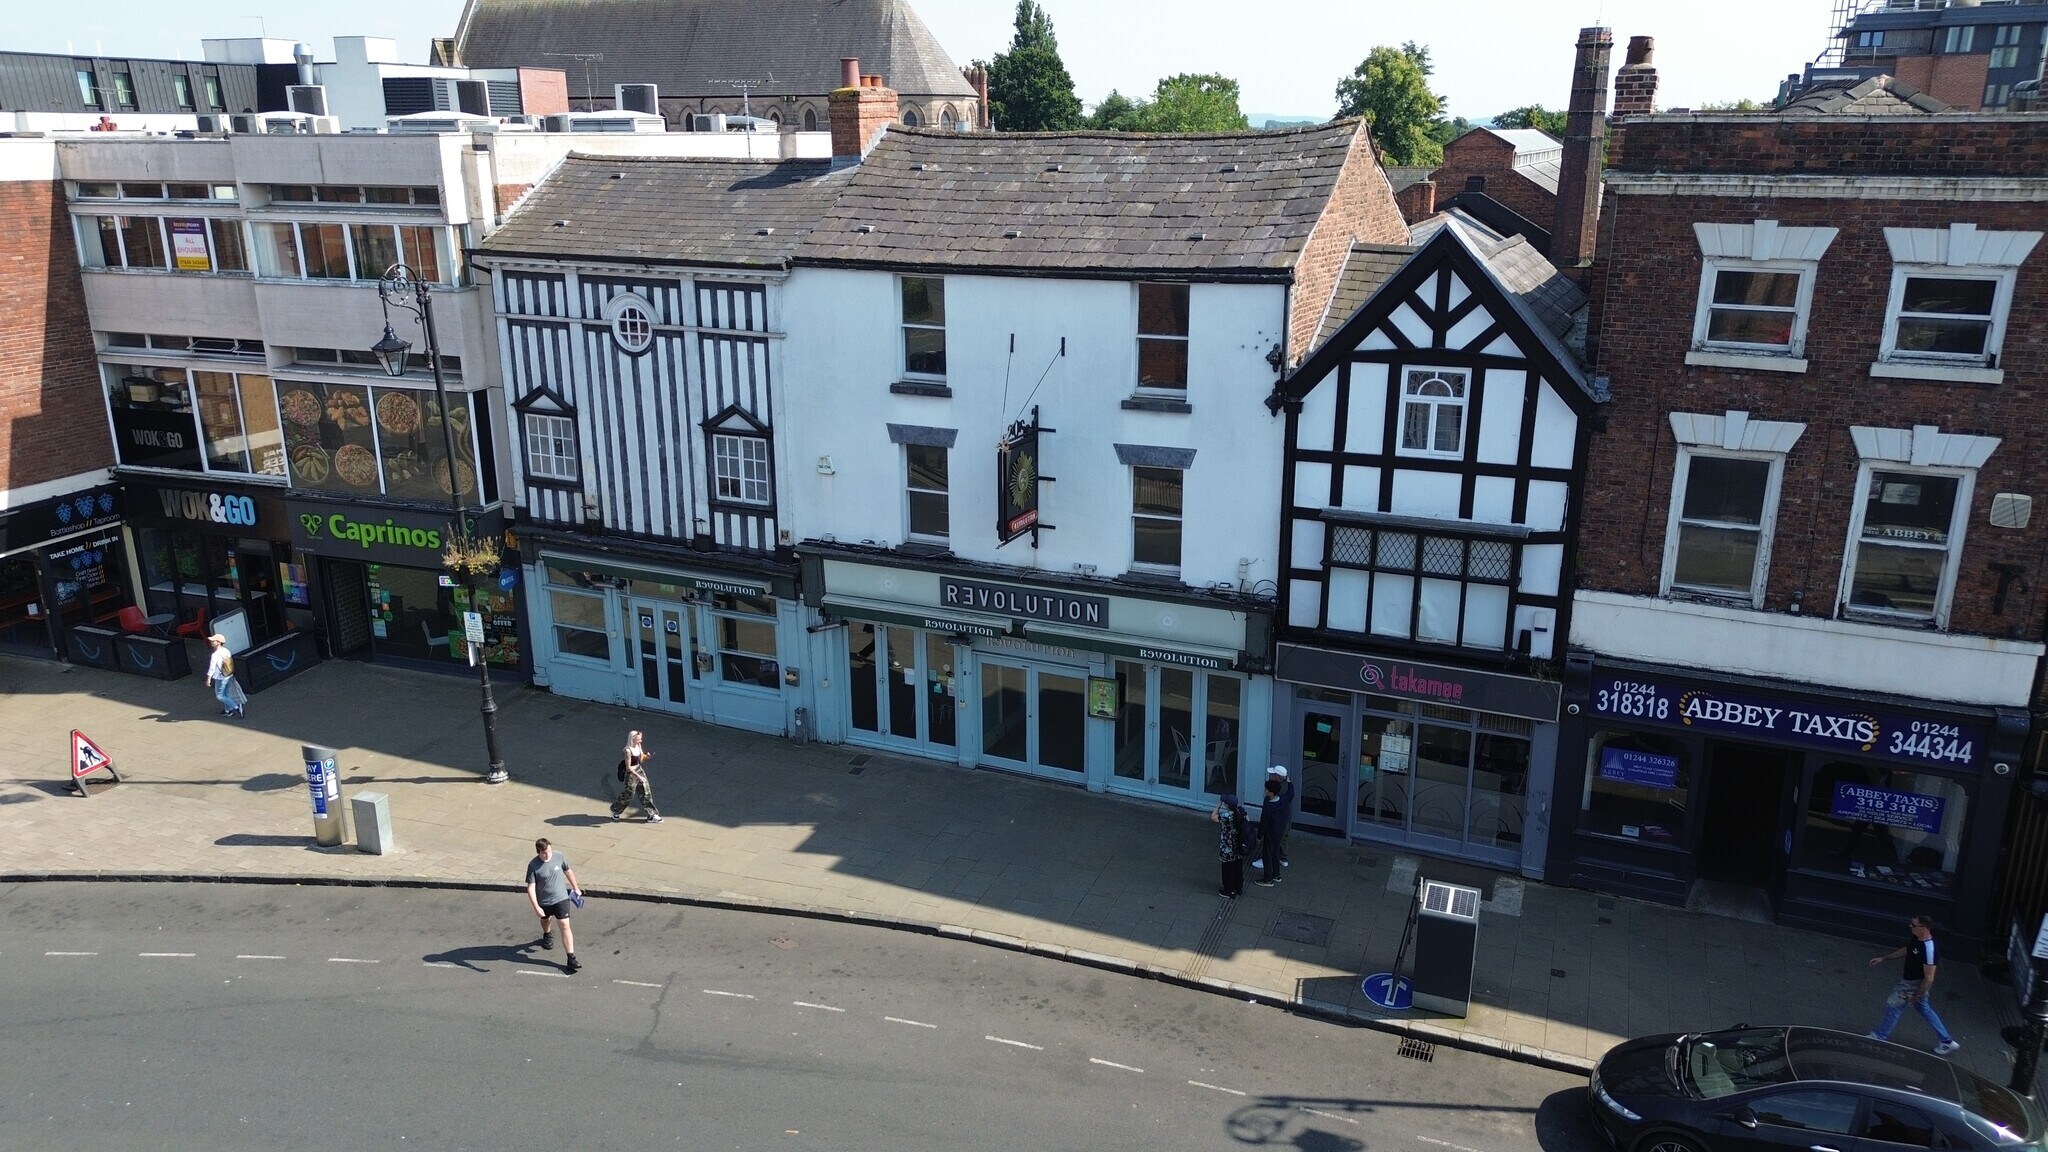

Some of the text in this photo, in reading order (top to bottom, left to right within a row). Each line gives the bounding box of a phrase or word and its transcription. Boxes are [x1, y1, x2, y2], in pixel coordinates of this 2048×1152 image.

[177, 246, 205, 254] ENQUIRIES
[132, 429, 183, 448] WOK&GO
[158, 488, 256, 526] WOK&GO
[50, 522, 85, 536] Bottleshop
[93, 514, 120, 525] Taproom
[328, 514, 442, 549] Caprinos
[1882, 528, 1932, 539] ABBEY
[49, 550, 66, 560] TAKE
[66, 545, 85, 555] HOME
[93, 538, 111, 548] DRINK
[695, 580, 756, 595] REVOLUTION
[947, 584, 1098, 622] REVOLUTION
[925, 620, 993, 636] REVOLUTION
[986, 637, 1076, 658] REVOLUTION
[1140, 649, 1218, 668] REVOLUTION
[1390, 665, 1463, 699] takamee
[1614, 680, 1656, 696] 01244
[1597, 689, 1668, 719] 318318
[1683, 698, 1874, 742] ABBEY TAXIS
[1911, 721, 1959, 737] 01244
[1889, 731, 1972, 764] 344344
[307, 764, 317, 773] AY
[1624, 753, 1675, 767] 01244 326326
[308, 774, 323, 782] ERE
[1603, 769, 1625, 777] ABBEY
[1846, 787, 1933, 808] ABBEY TAXIS
[1857, 797, 1917, 814] 318 318
[1836, 809, 1867, 817] AIRPORTS
